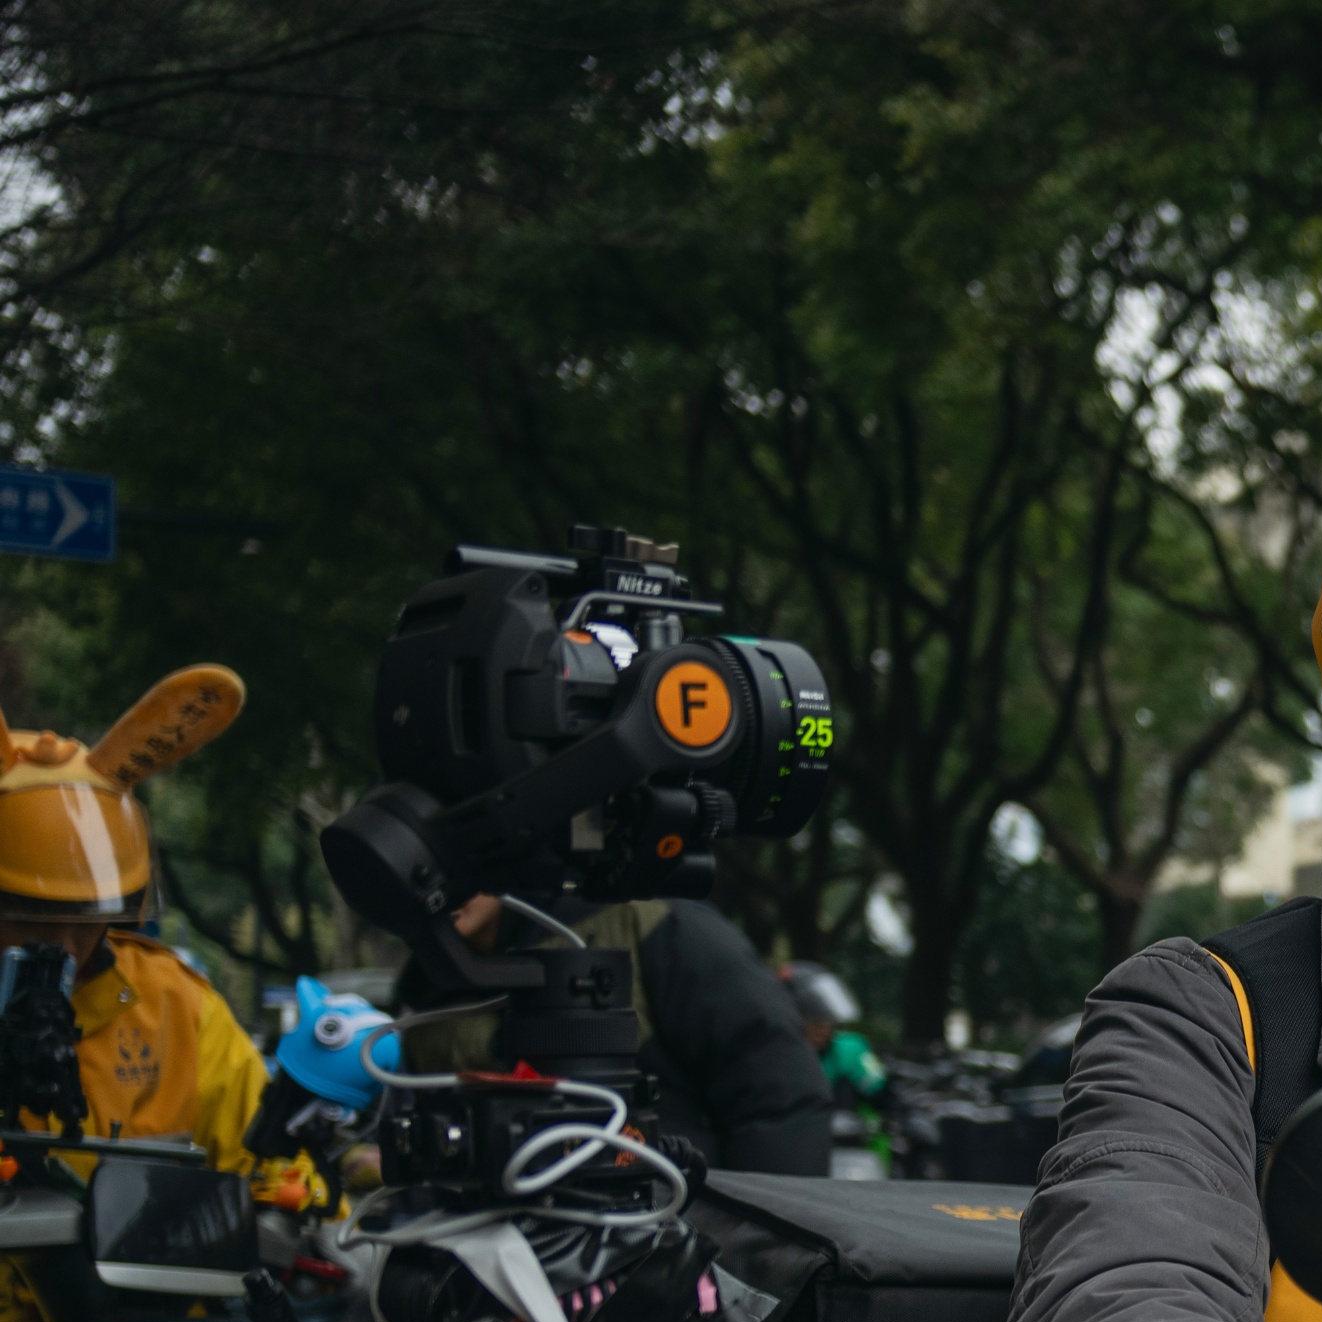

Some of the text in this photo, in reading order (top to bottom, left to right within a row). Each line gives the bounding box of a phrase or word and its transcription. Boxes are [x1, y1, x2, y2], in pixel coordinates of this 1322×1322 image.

[617, 575, 663, 596] Nitze
[680, 683, 707, 729] F
[799, 715, 834, 748] 25
